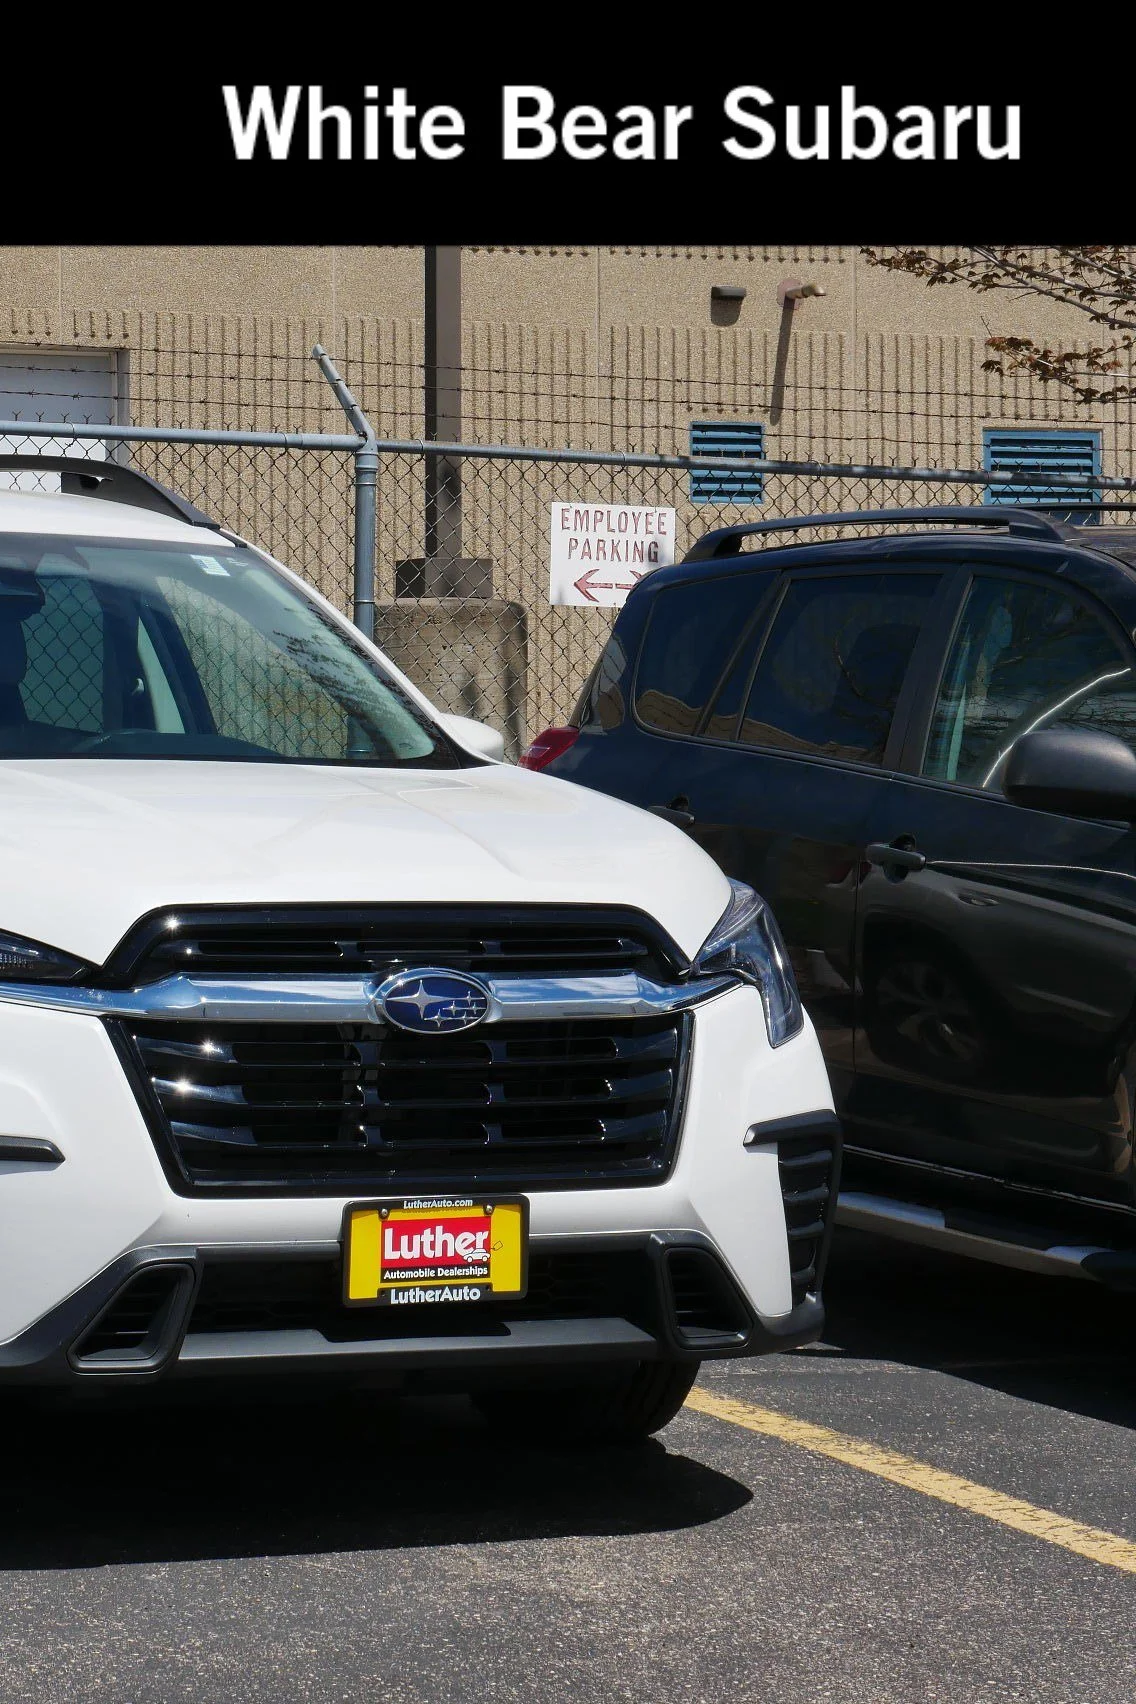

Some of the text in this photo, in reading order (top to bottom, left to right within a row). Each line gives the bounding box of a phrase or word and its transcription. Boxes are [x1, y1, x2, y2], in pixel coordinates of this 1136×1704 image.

[561, 507, 667, 535] EMPLOYEE
[568, 537, 659, 563] PARKING
[403, 1199, 473, 1209] LutherAuto.com
[383, 1225, 489, 1260] Luther
[383, 1266, 488, 1280] Automobile Dealerships
[390, 1285, 481, 1304] LutherAuto
